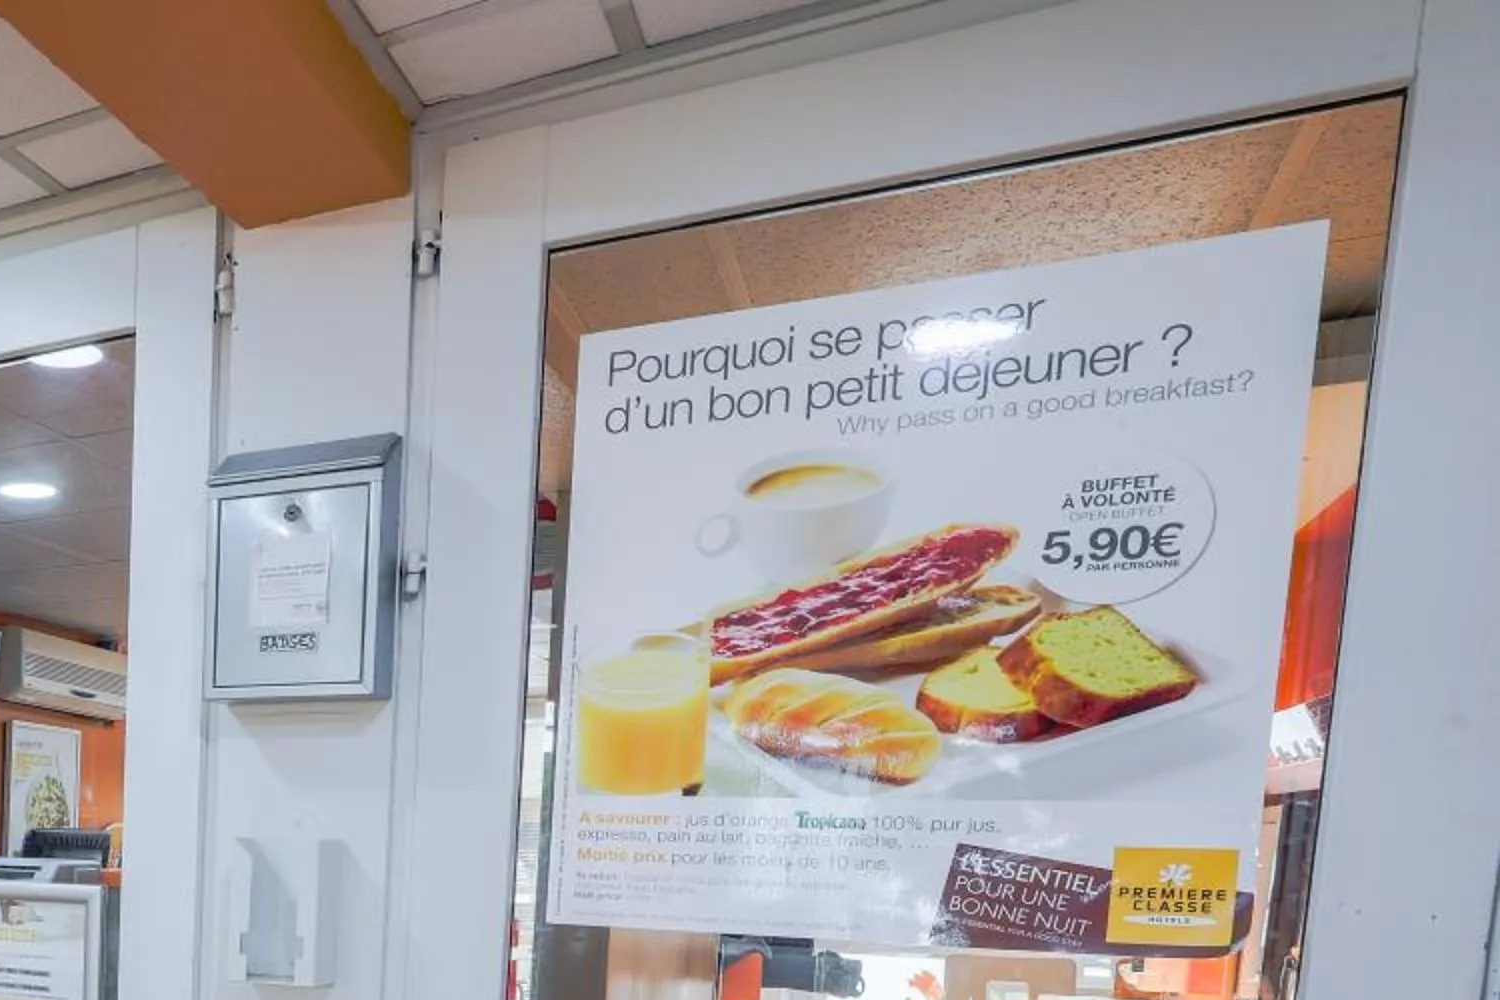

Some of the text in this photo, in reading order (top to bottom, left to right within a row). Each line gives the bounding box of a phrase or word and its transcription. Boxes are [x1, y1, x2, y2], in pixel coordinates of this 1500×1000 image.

[608, 325, 796, 387] Pourquoi
[808, 326, 863, 360] se
[604, 395, 694, 435] d'un
[707, 386, 791, 423] bon
[805, 362, 904, 421] petit
[1161, 323, 1194, 367] ?
[836, 368, 1255, 436] Why pass on a good breakfast?
[1080, 473, 1161, 494] BUFFET
[1080, 485, 1177, 509] VOLONTÉ
[1068, 505, 1165, 523] OPEN BUFFET
[1040, 521, 1186, 571] 5,90€
[1085, 558, 1181, 573] PAR PERSONNE
[597, 812, 671, 826] savourer
[684, 812, 708, 829] jus
[794, 809, 868, 831] Tropicana
[873, 814, 924, 832] 100%
[929, 817, 962, 833] pur
[656, 827, 691, 844] pain
[694, 830, 717, 843] au
[633, 847, 668, 864] prix
[670, 850, 708, 866] pour
[713, 850, 737, 866] les
[800, 854, 820, 870] de
[954, 874, 1072, 912] POUR UNE
[1118, 886, 1228, 902] PREMIERE
[949, 895, 1093, 937] BONNE NUIT
[1132, 899, 1212, 915] CLASSE
